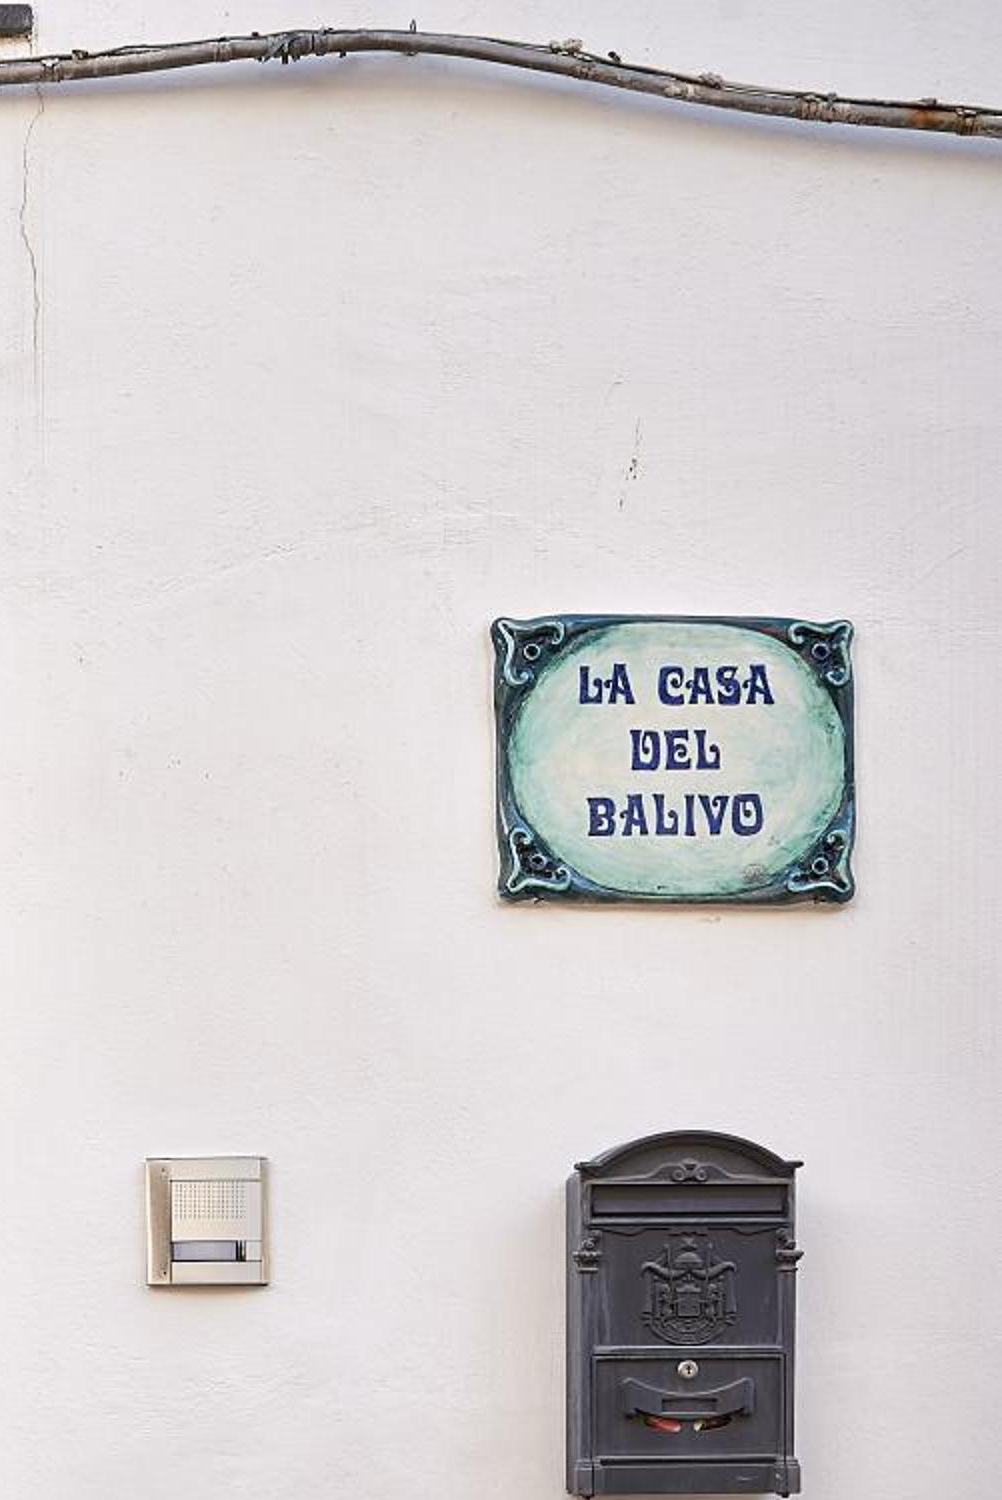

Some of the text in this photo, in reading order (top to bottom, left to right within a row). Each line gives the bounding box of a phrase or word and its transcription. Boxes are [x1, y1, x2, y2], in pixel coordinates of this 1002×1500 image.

[578, 663, 775, 706] LA CASA
[629, 729, 721, 771] DEL
[586, 793, 764, 836] BALIVO
